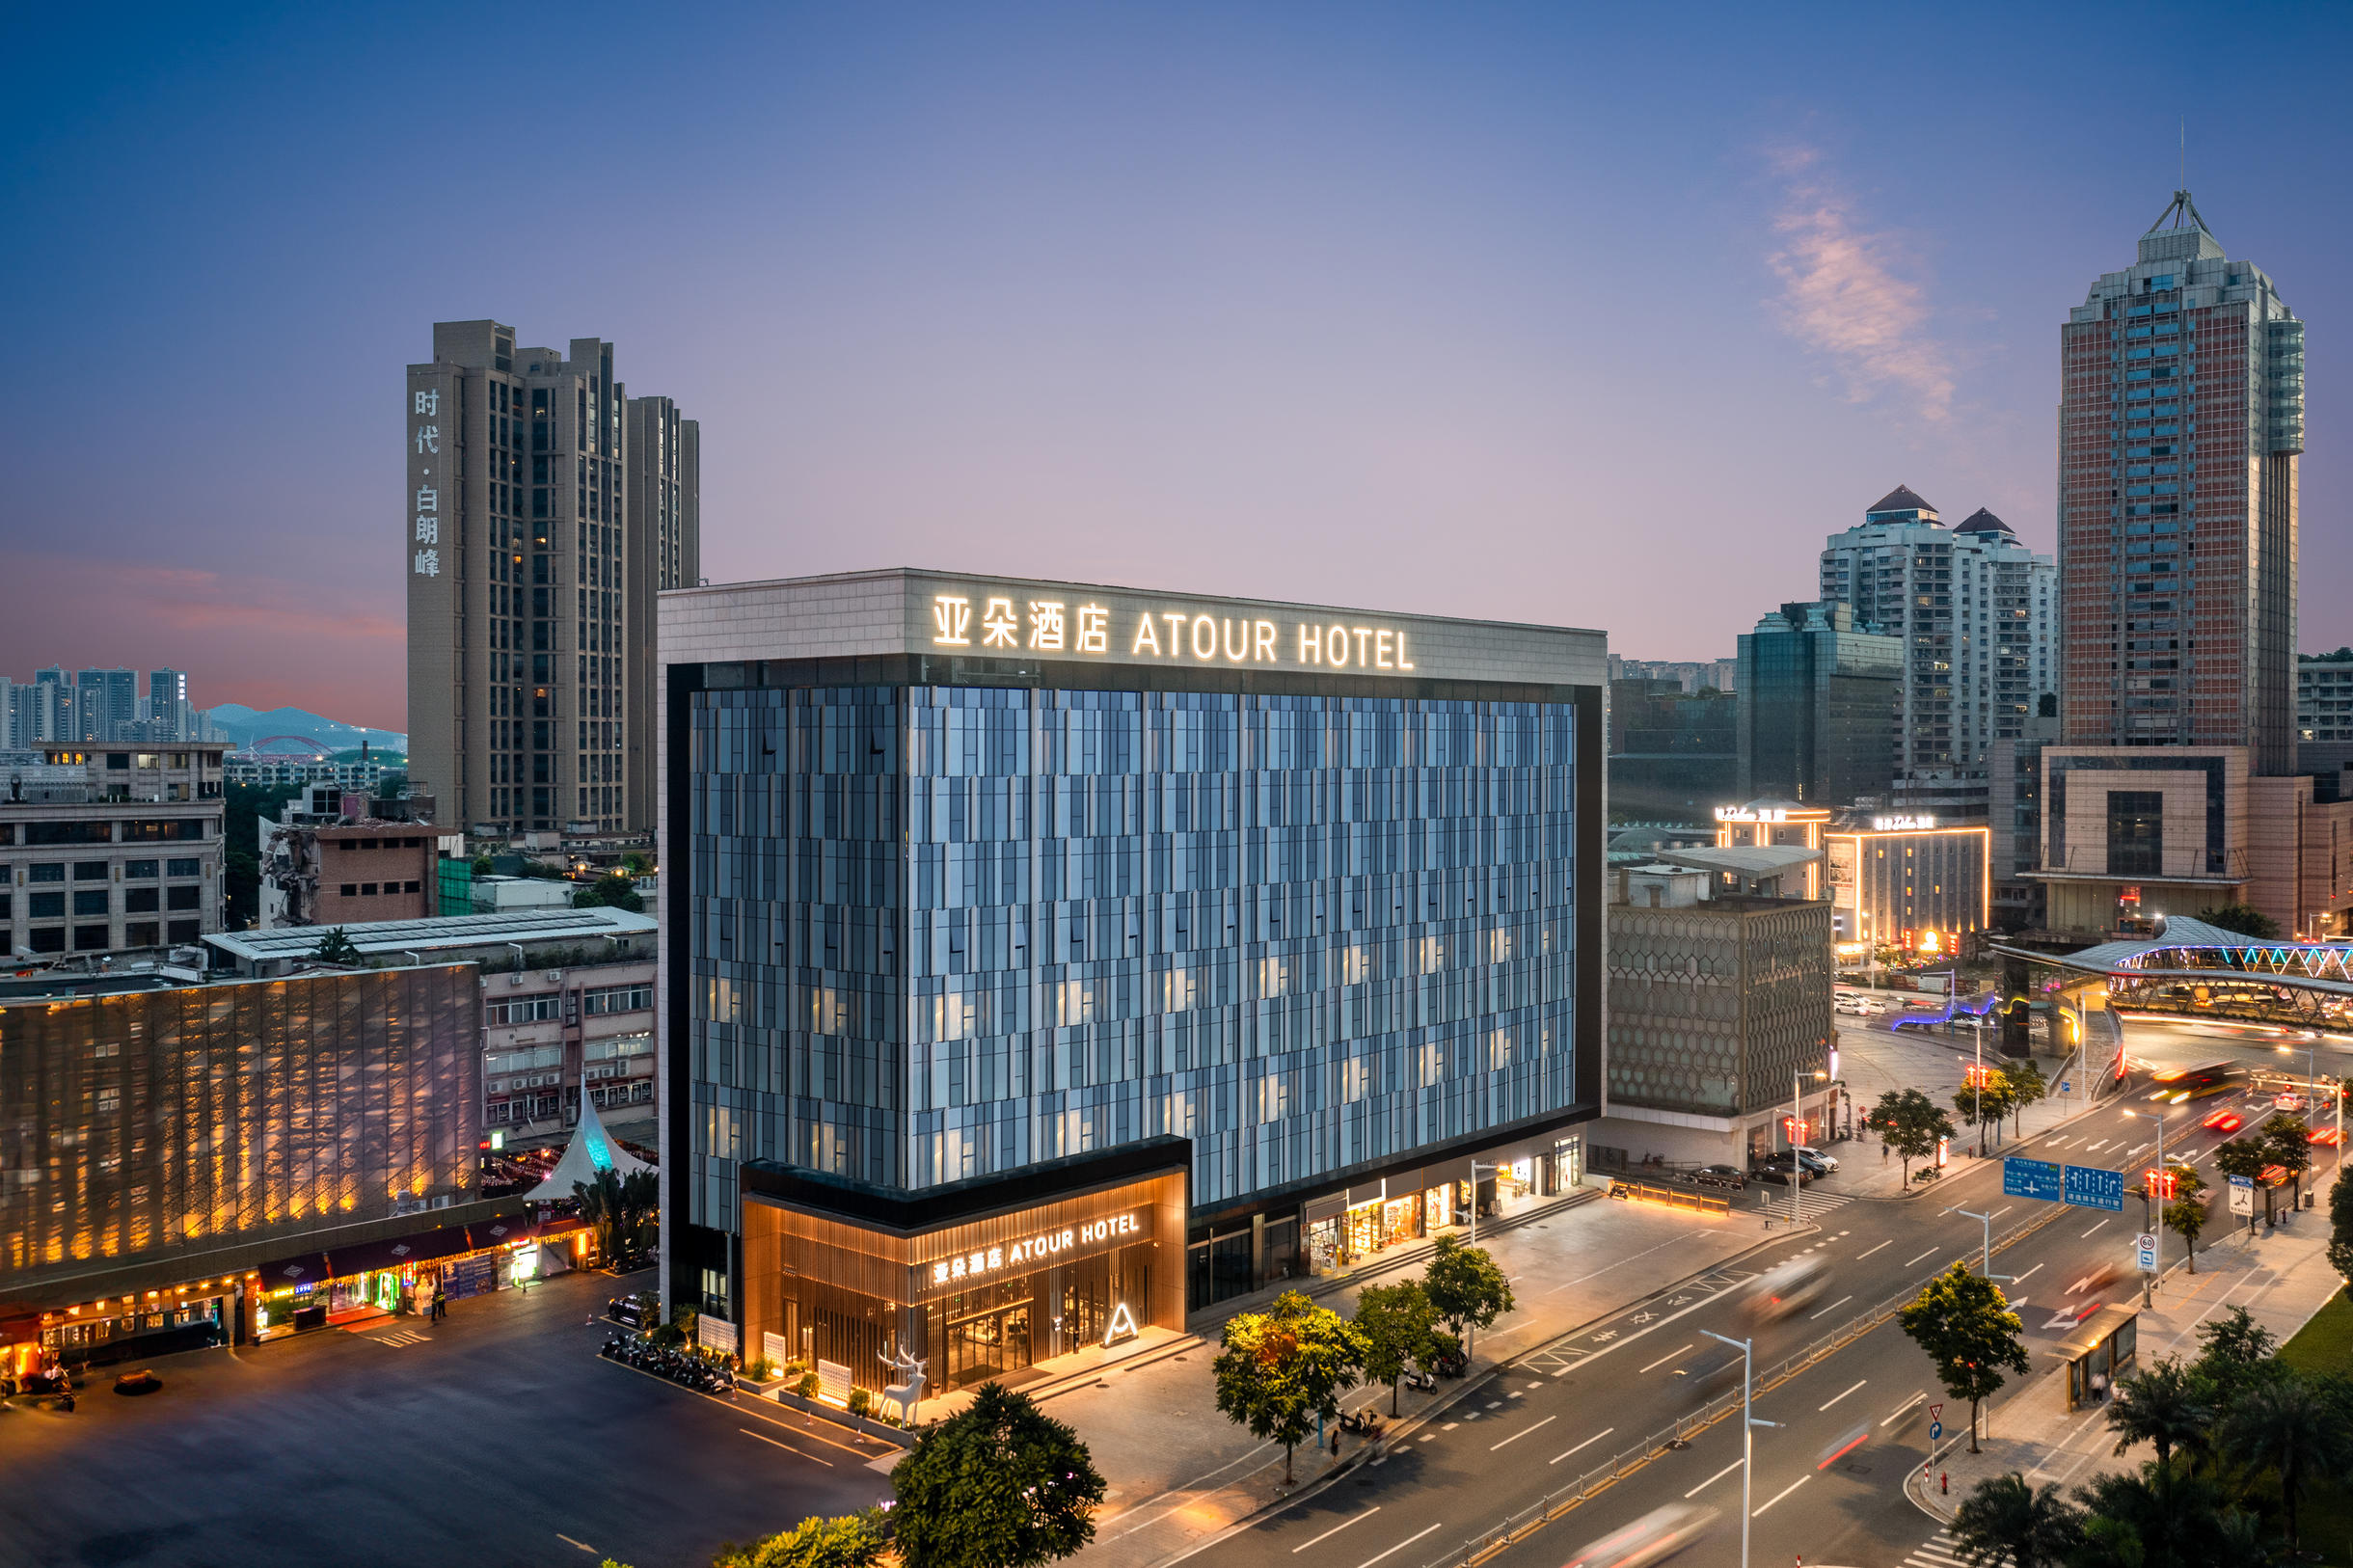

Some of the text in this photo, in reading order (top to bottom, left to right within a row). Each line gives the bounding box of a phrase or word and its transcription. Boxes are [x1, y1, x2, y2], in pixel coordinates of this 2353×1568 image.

[933, 596, 1414, 670] 亚朵酒店 ATOUR HOTEL
[933, 1214, 1140, 1284] 亚朵酒店 ATOUR HOTEL
[2142, 1238, 2152, 1247] 60
